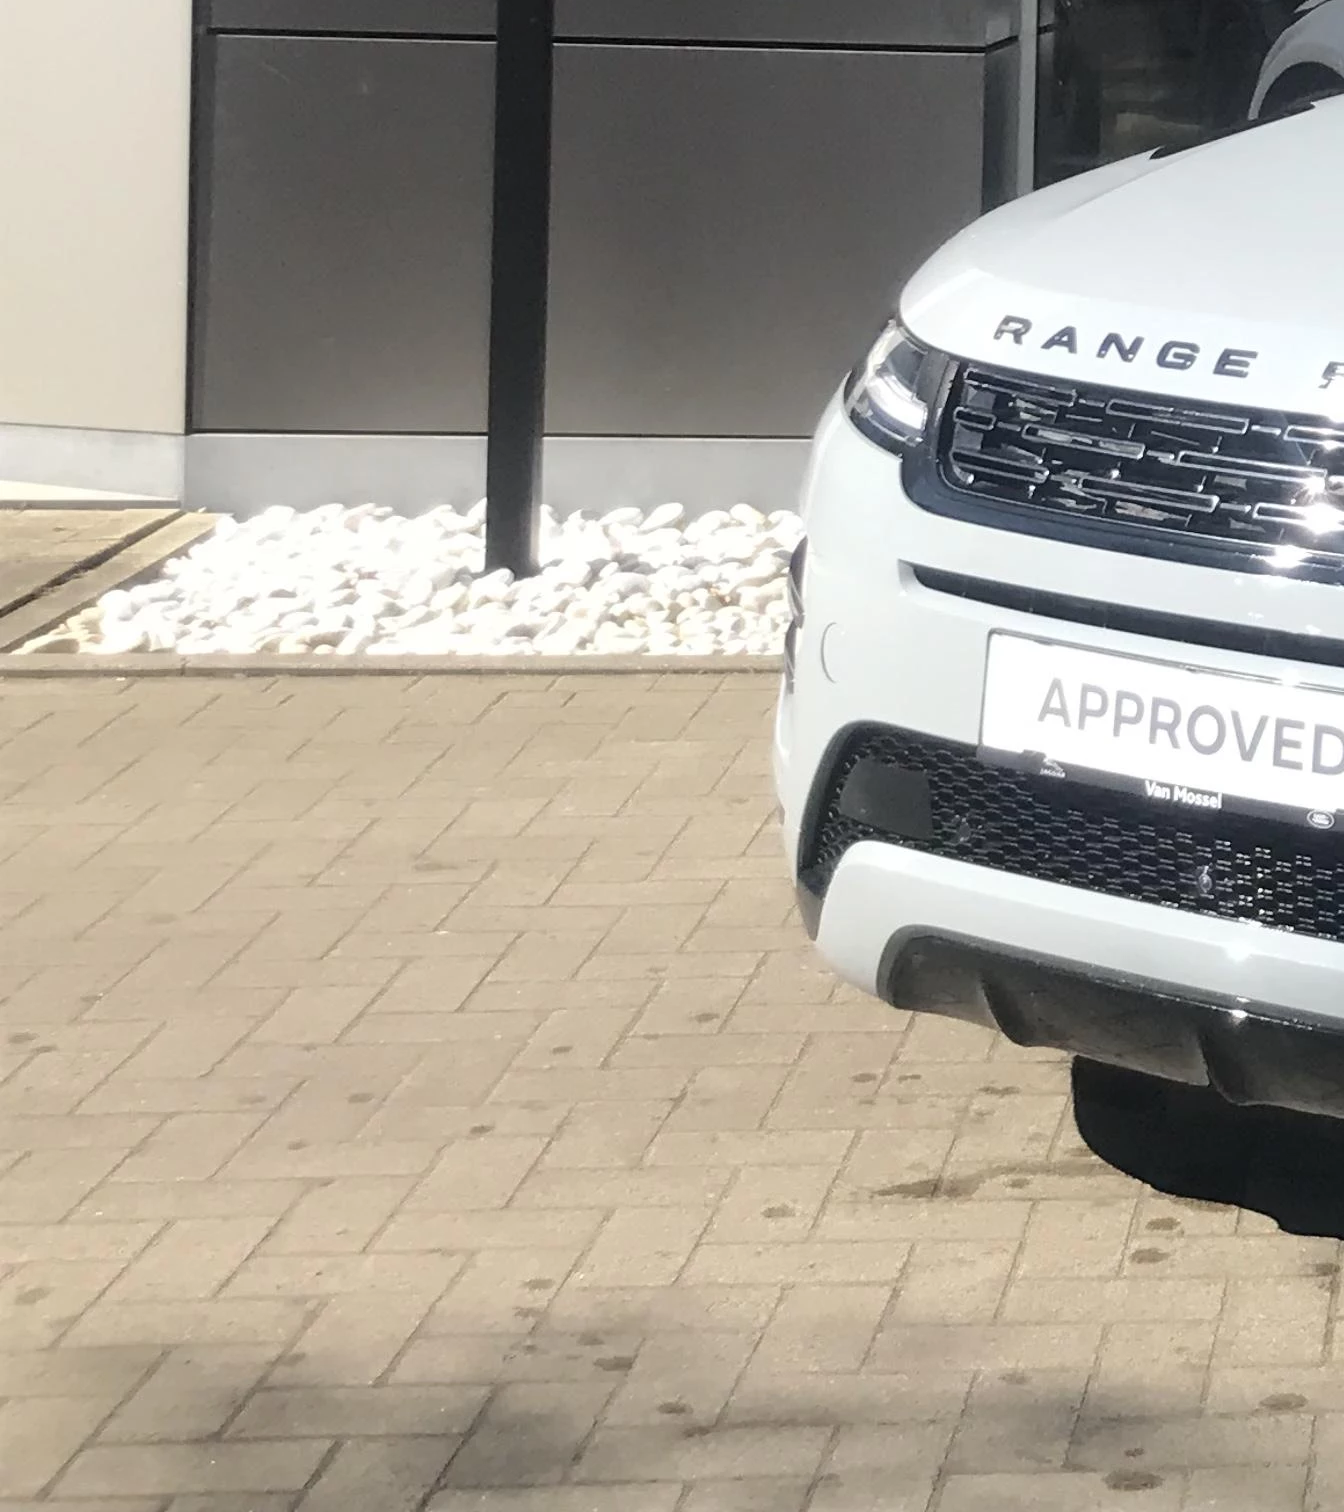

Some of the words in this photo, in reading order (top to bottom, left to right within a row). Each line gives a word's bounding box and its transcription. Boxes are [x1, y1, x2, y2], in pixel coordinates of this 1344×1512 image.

[993, 314, 1259, 380] RANGE
[1144, 779, 1170, 800] Van
[1173, 785, 1223, 809] Mossel
